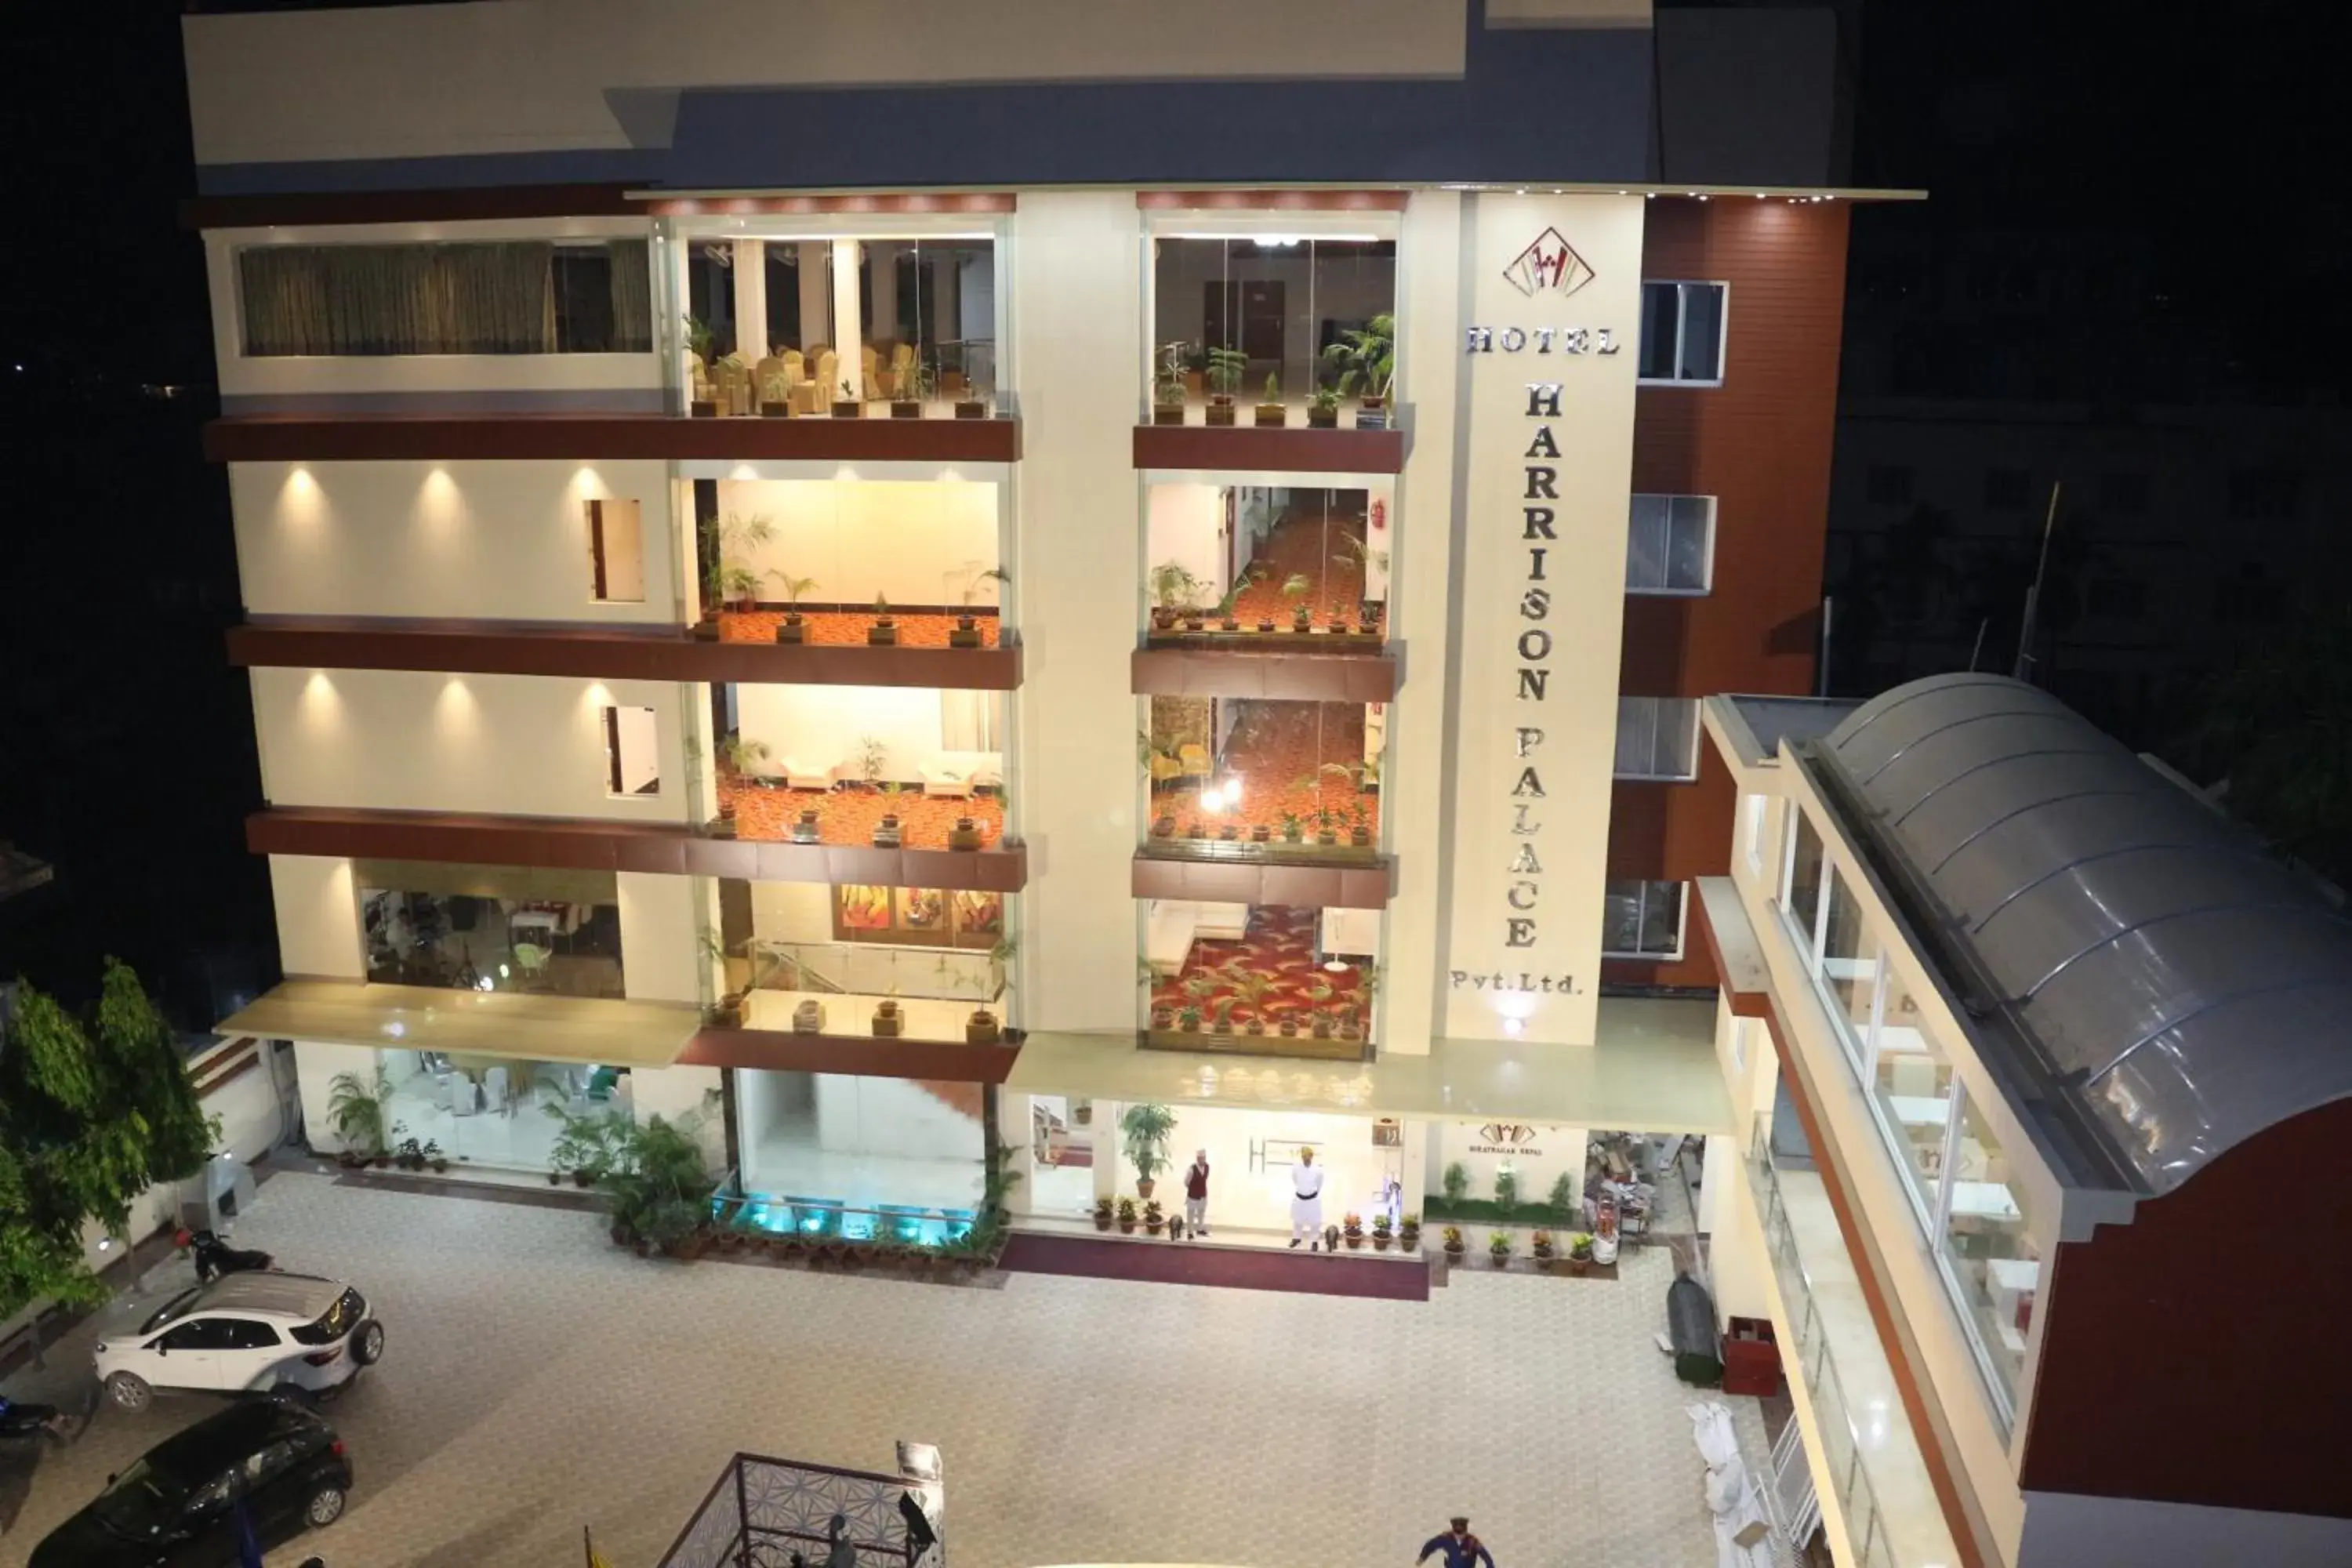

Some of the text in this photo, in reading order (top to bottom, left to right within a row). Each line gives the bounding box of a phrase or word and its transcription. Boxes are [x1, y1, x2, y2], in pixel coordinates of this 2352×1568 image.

[1467, 326, 1621, 355] HOTEL
[1505, 383, 1563, 948] HARRISON PALACE
